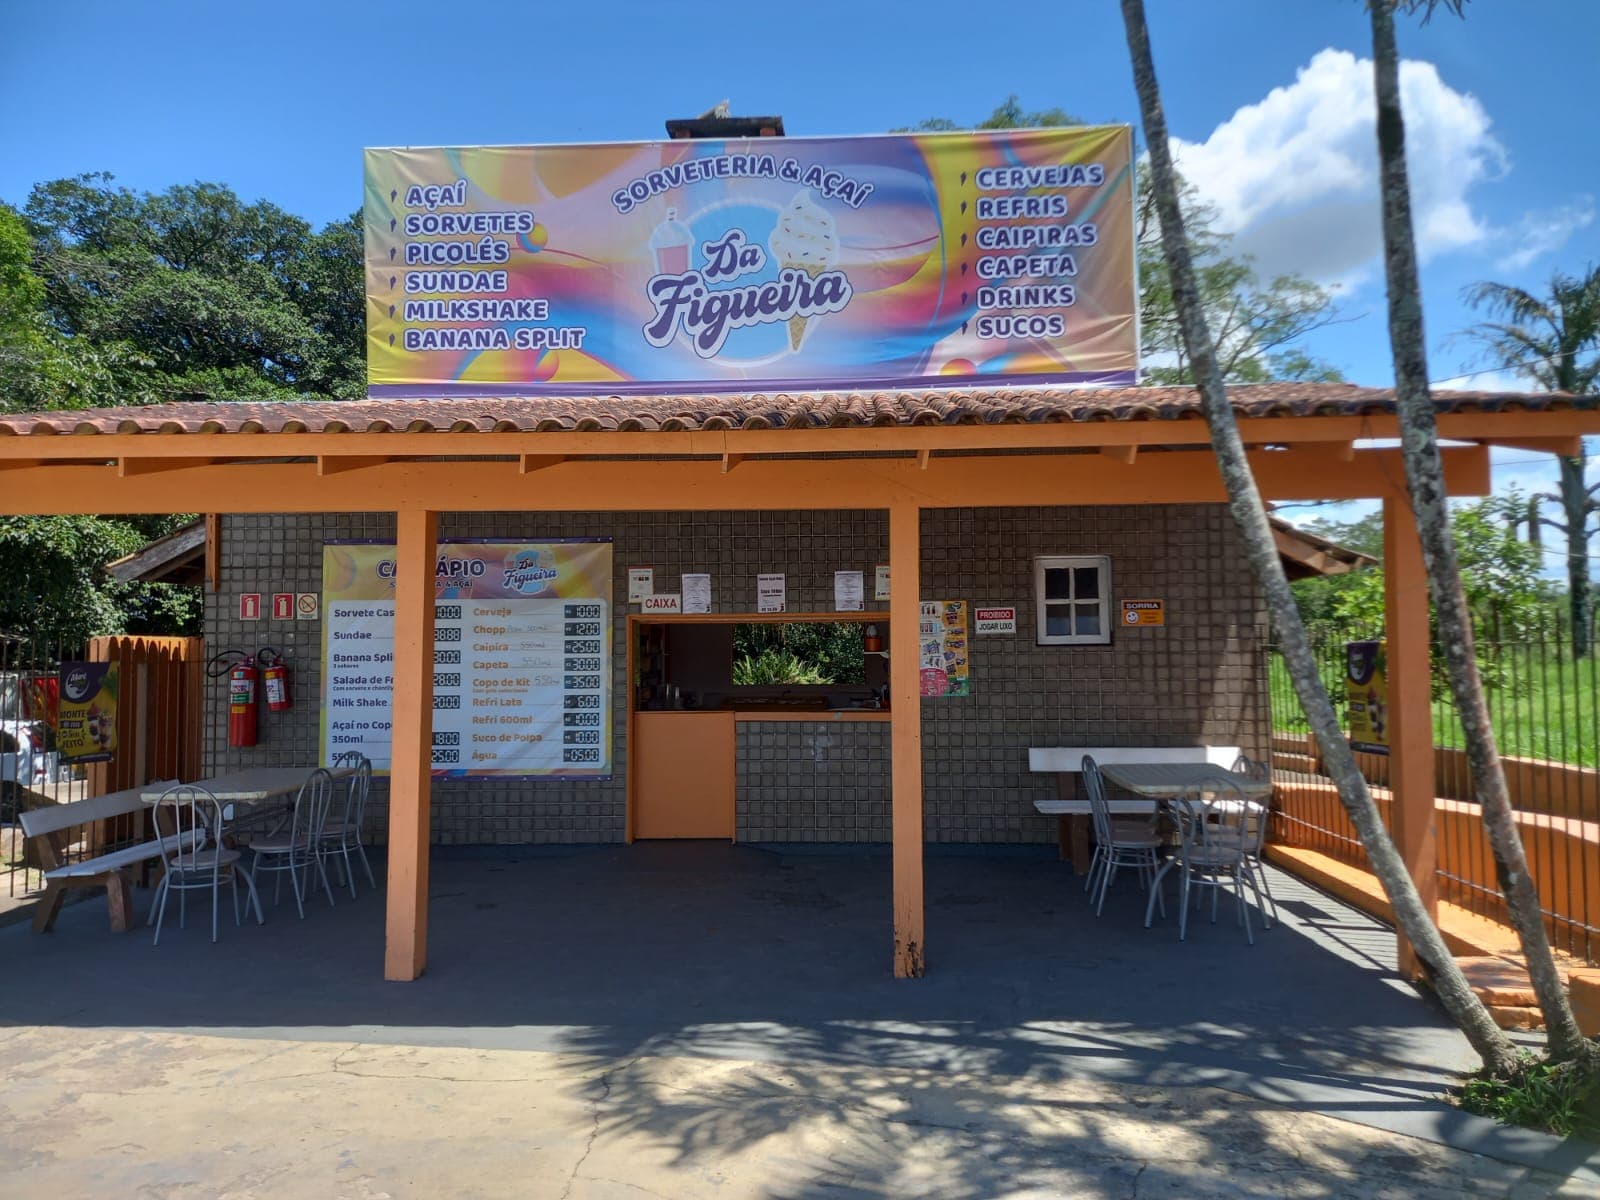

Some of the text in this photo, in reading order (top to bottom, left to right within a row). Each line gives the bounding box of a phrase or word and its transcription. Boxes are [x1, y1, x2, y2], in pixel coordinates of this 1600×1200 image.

[977, 166, 1104, 188] CERVEJAS
[614, 156, 873, 211] SORVETERIA & AÇAÍ
[405, 179, 467, 210] AÇAÍ
[977, 197, 1067, 218] REFRIS
[405, 213, 533, 234] SORVETES
[977, 225, 1097, 247] CAIPIRAS
[406, 238, 509, 263] PICOLÉS
[705, 232, 761, 278] Da
[977, 256, 1076, 277] CAPETA
[405, 271, 507, 292] SUNDAE
[978, 287, 1075, 308] DRINKS
[405, 300, 548, 320] MILKSHAKE
[648, 273, 847, 351] Figueira
[977, 316, 1064, 337] SUCOS
[405, 328, 585, 350] BANANA SPLIT
[519, 559, 534, 570] Da
[503, 567, 558, 590] Figueira
[645, 598, 677, 609] CAIXA
[334, 608, 395, 618] Sorvete Cas
[473, 607, 512, 618] Cerveja
[980, 611, 1011, 619] PROIBIDO
[473, 625, 506, 635] Chopp
[999, 622, 1013, 630] LIXO
[333, 630, 372, 640] Sundae
[473, 642, 509, 652] Caipira
[572, 641, 600, 653] 25.00
[333, 653, 393, 664] Banana Spli
[572, 658, 600, 670] 30.00
[473, 660, 509, 671] Capeta
[333, 675, 367, 685] Salada
[370, 675, 383, 685] de
[472, 677, 530, 688] Copo de Kit
[572, 676, 599, 688] 35.00
[333, 698, 388, 707] Milk Shake
[472, 698, 523, 706] Refri Lata
[472, 715, 533, 724] Refri 600ml
[332, 720, 392, 732] Açaí no Cop
[332, 735, 364, 744] 350ml
[472, 734, 497, 742] Suco
[498, 733, 512, 742] de
[471, 749, 497, 761] Água
